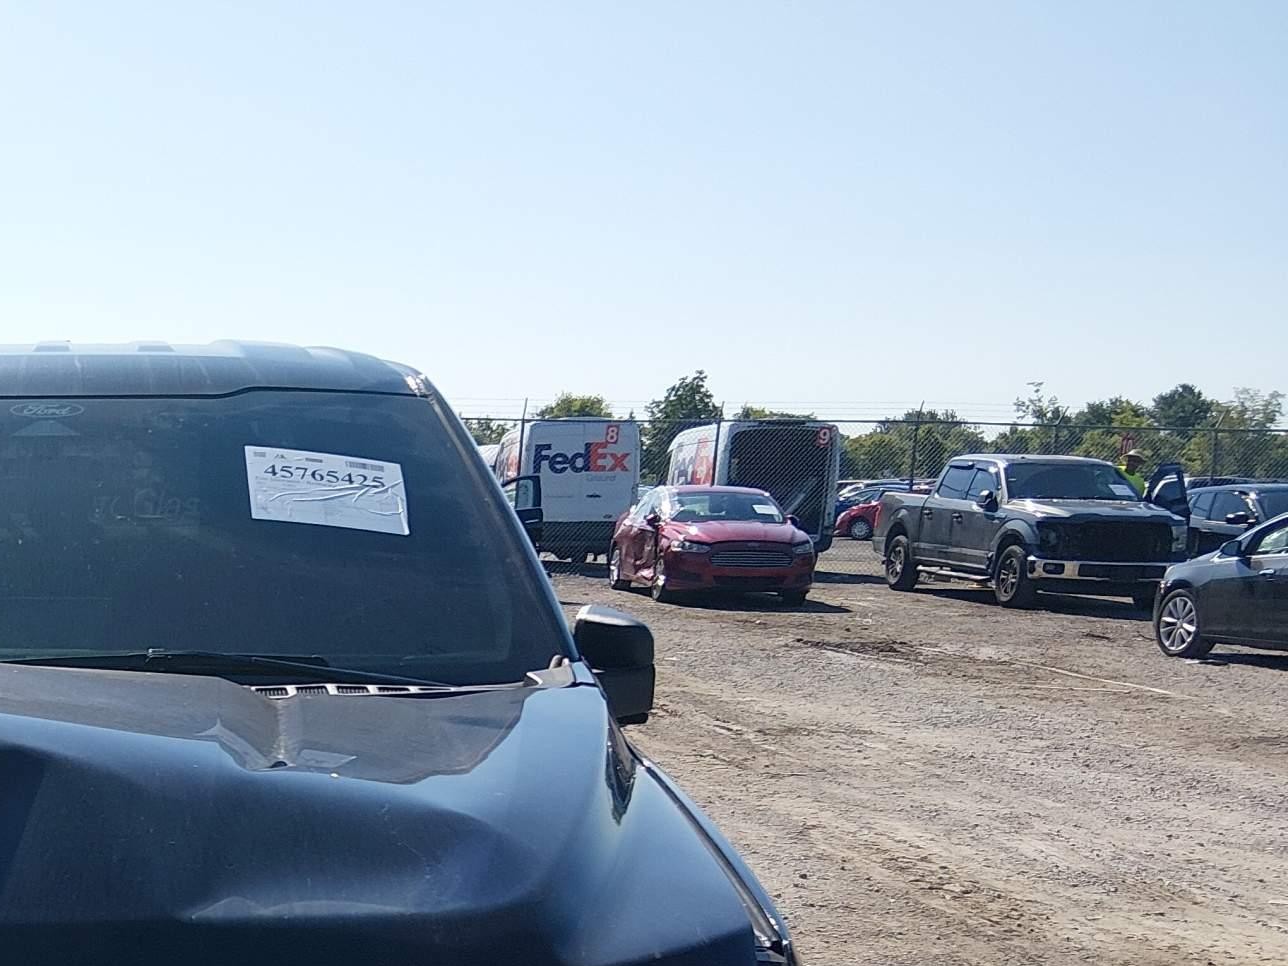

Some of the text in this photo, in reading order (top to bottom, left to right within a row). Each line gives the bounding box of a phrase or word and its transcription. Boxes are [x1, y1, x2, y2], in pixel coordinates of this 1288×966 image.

[606, 427, 618, 443] 8
[818, 429, 830, 444] 9
[533, 443, 630, 474] FedEx
[264, 464, 385, 489] 45765425
